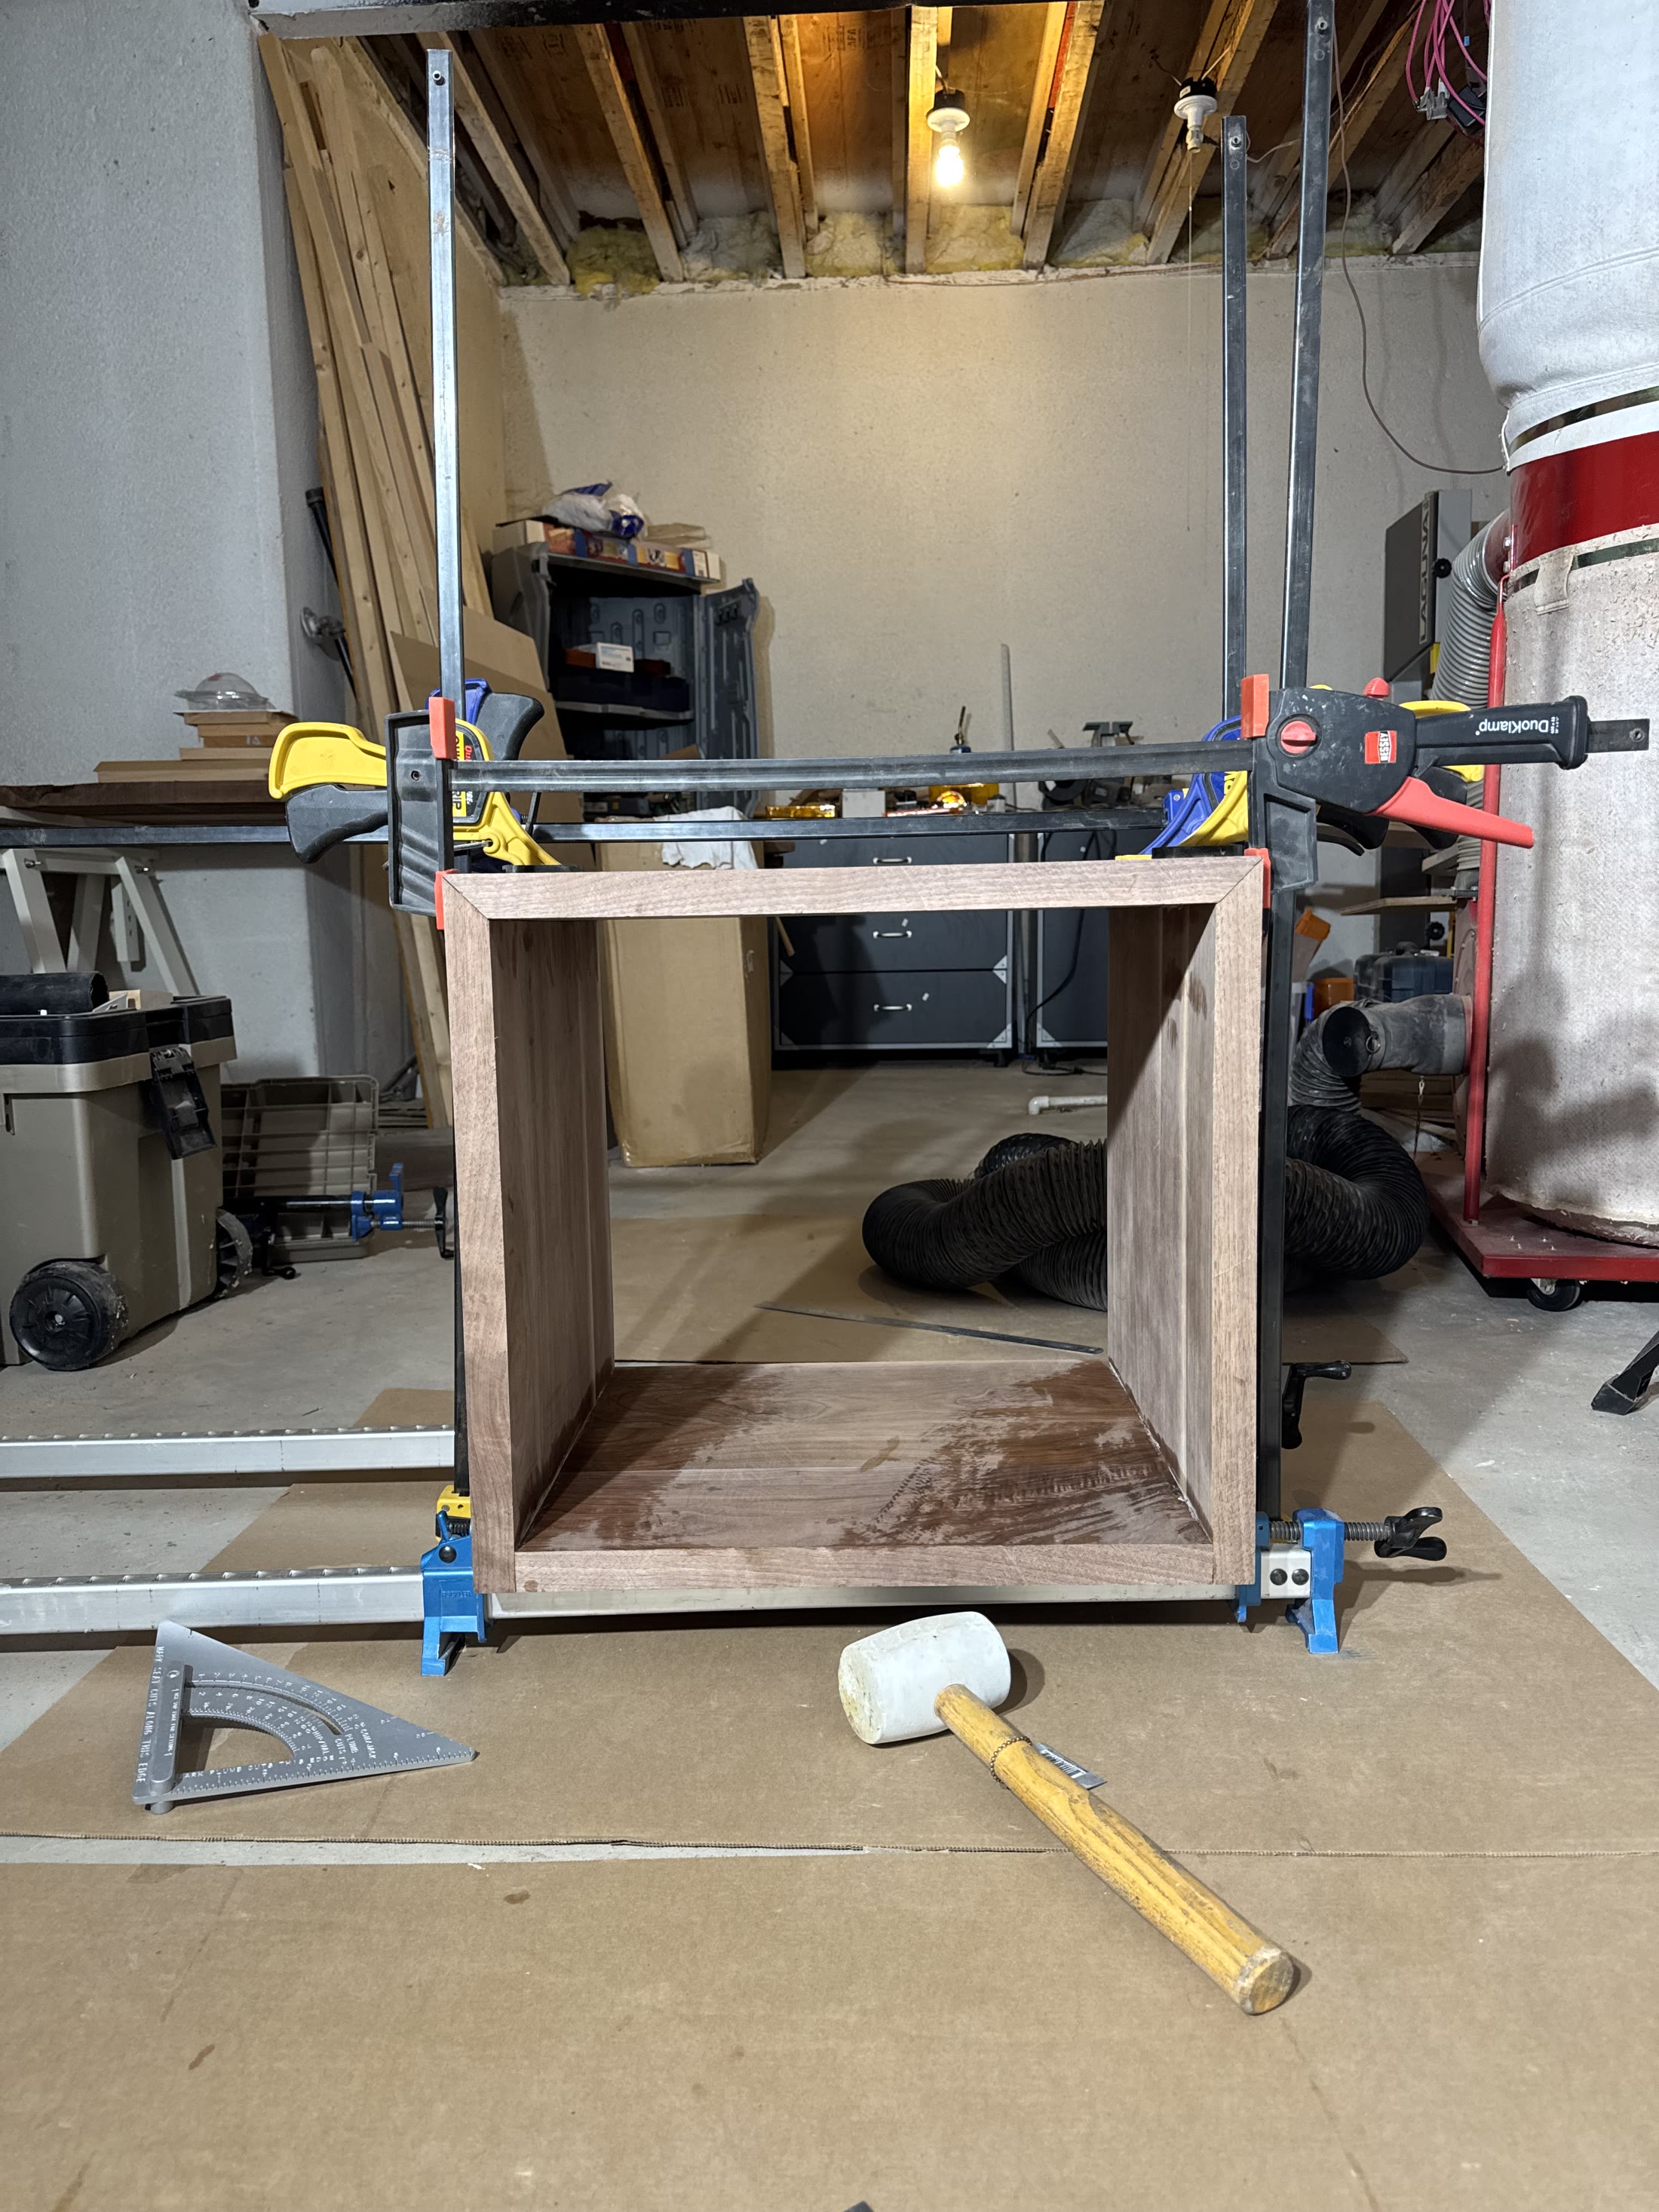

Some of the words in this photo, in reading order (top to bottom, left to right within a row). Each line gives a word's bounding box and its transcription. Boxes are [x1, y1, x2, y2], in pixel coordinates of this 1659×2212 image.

[1478, 718, 1549, 733] DuoKlamp
[1378, 733, 1389, 761] BESSEY
[140, 1739, 151, 1758] THIS
[335, 1738, 347, 1754] CUTS
[136, 1763, 147, 1783] EDGE
